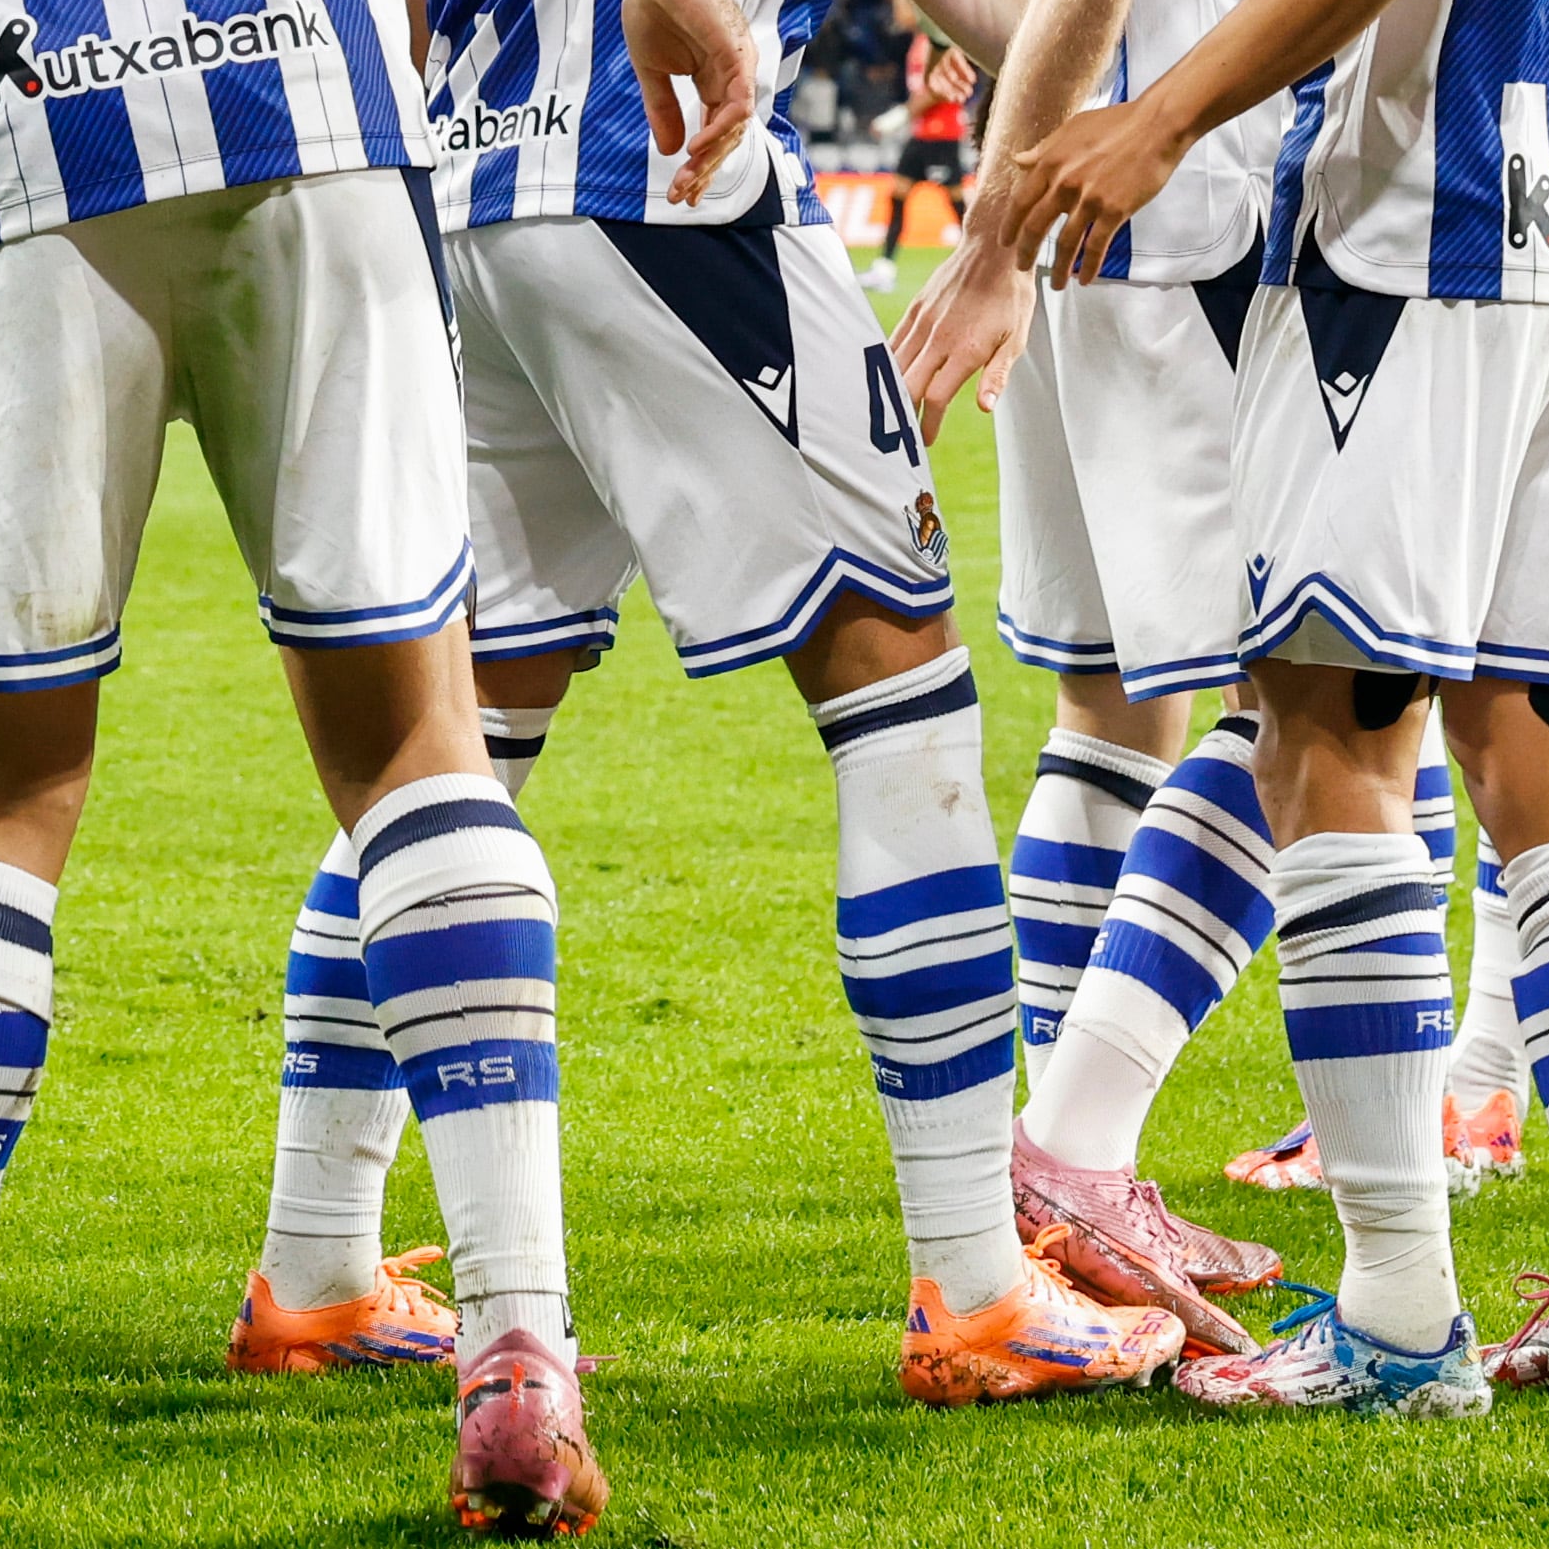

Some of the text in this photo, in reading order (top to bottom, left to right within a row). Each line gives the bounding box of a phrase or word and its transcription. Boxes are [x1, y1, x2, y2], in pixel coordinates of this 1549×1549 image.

[436, 94, 572, 152] abank
[864, 342, 921, 468] 4
[283, 1052, 320, 1074] RS
[437, 1055, 516, 1092] RS
